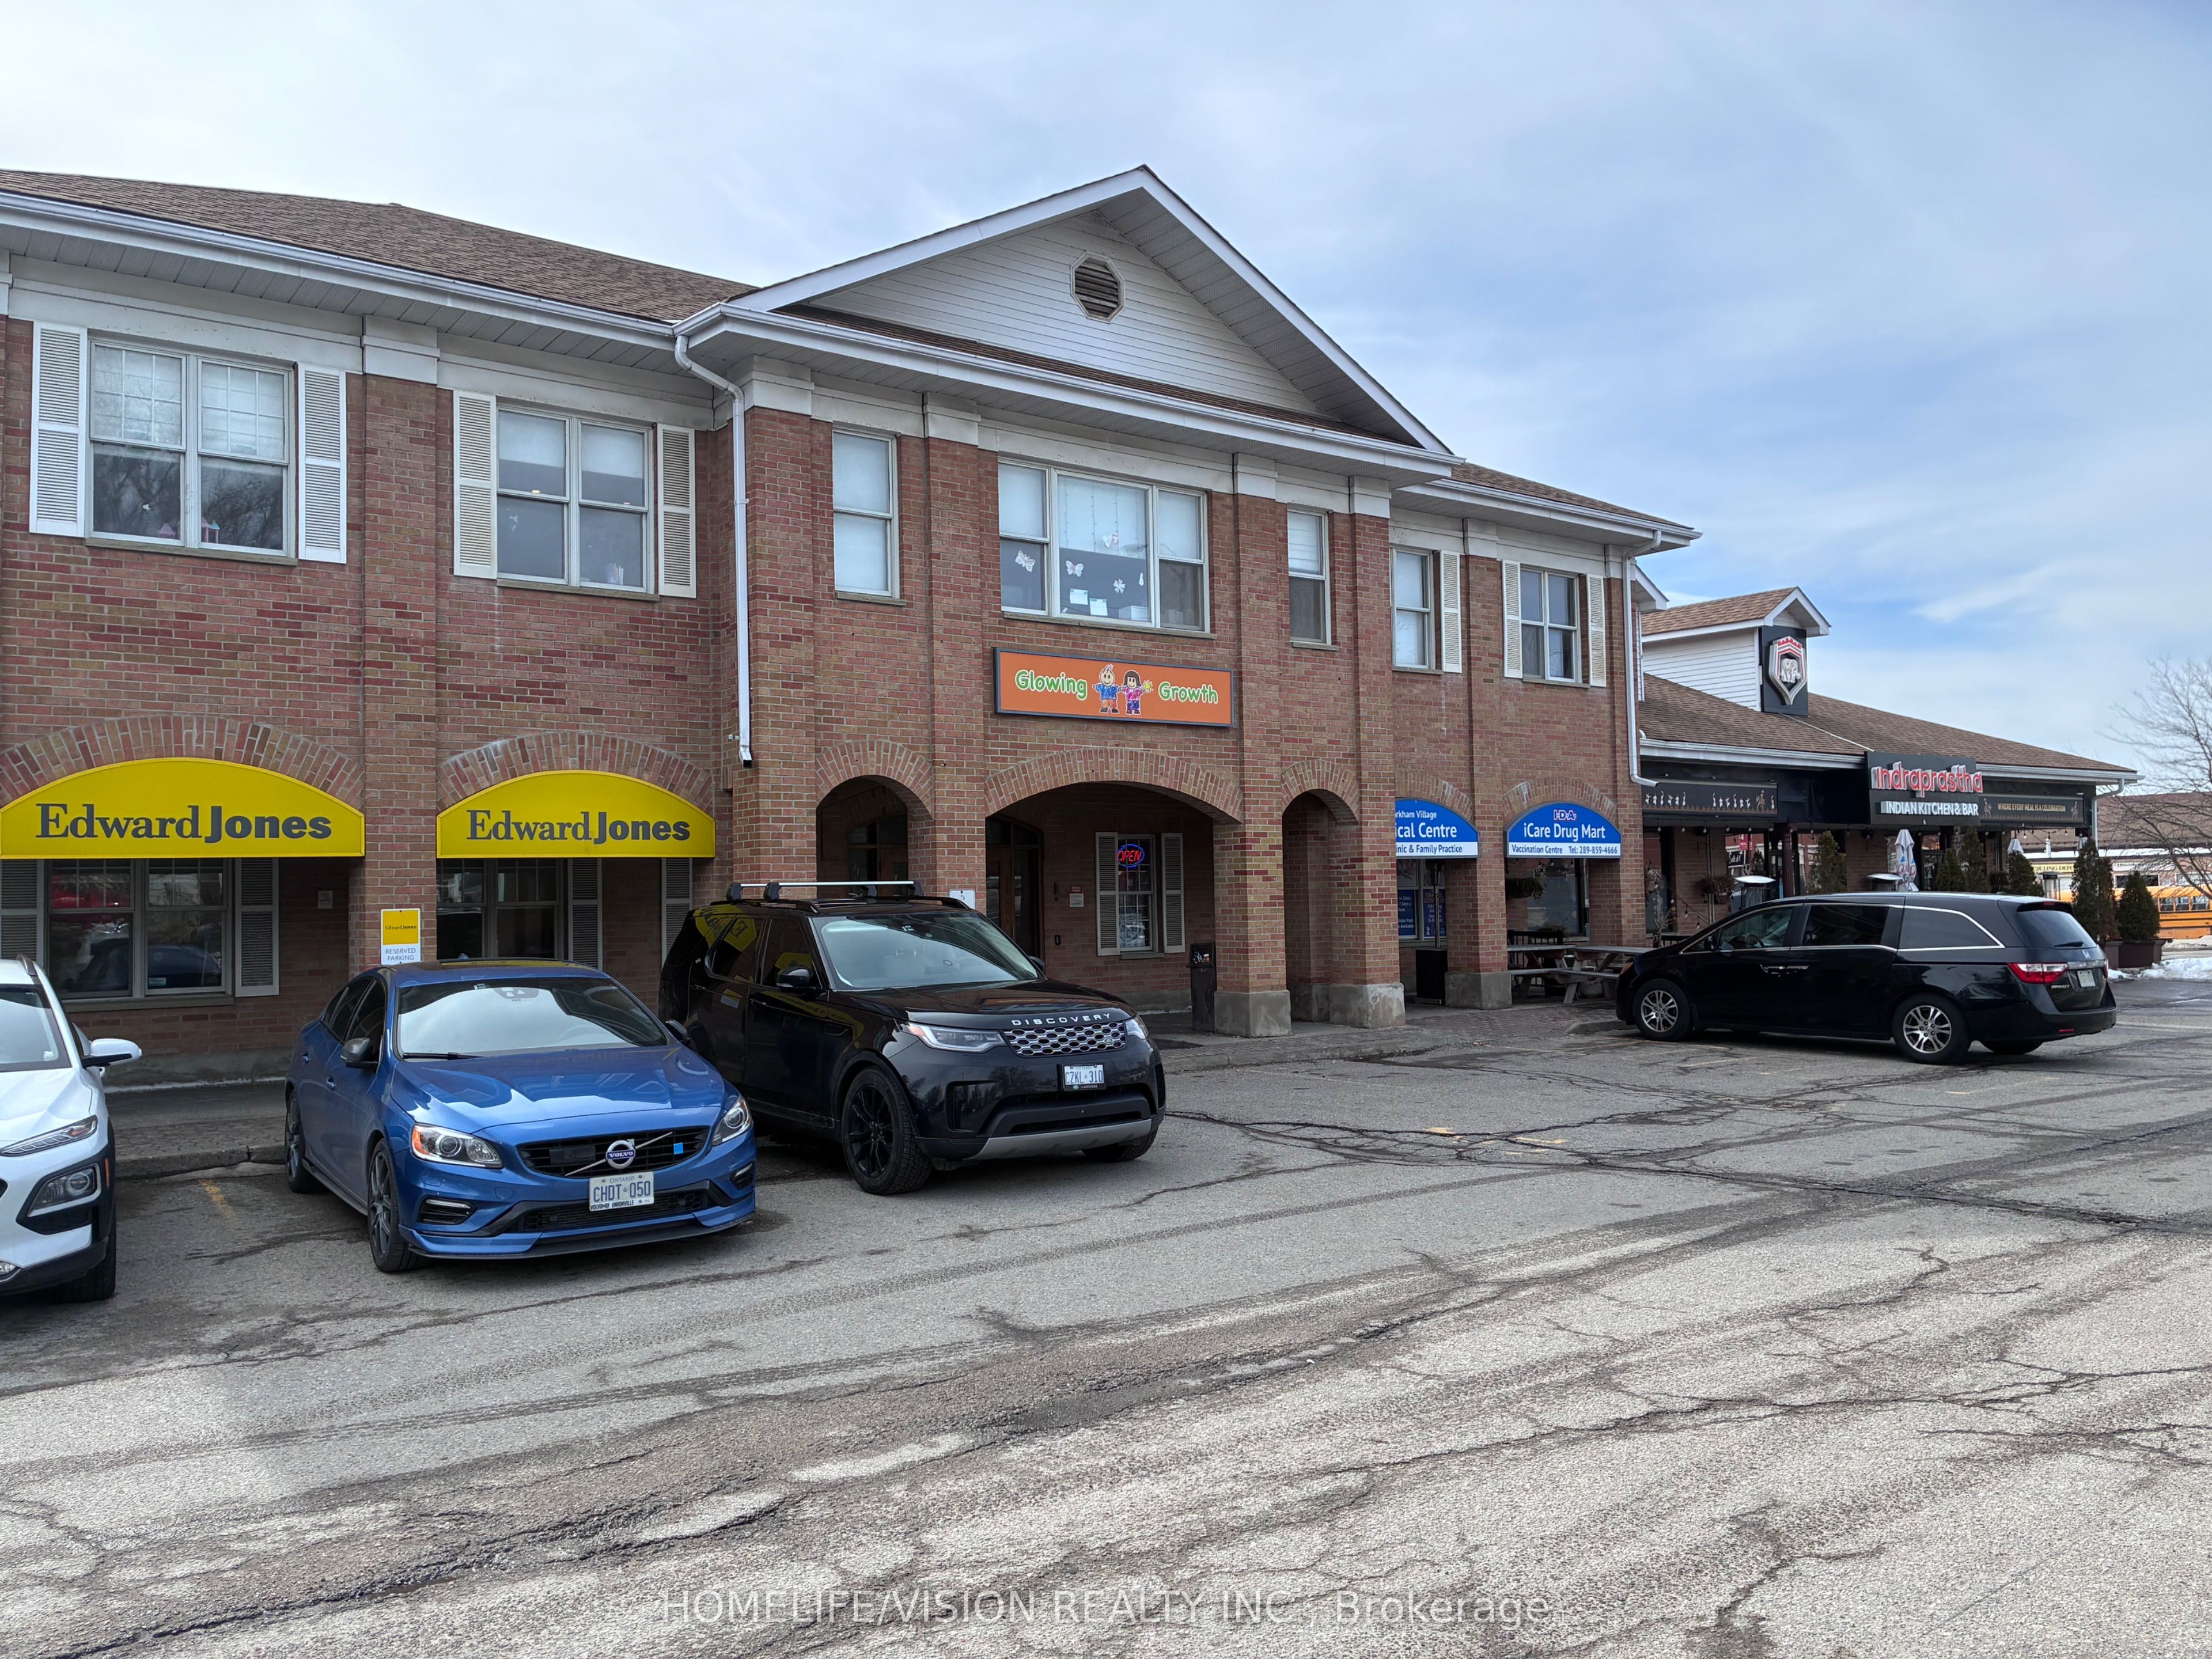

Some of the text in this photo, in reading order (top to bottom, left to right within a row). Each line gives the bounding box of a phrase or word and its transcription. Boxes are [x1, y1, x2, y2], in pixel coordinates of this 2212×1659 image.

[1014, 669, 1219, 704] Glowing Growth
[1395, 810, 1437, 820] rkham Village
[1882, 801, 1979, 816] INDIAN KITCHEN & BAR
[36, 803, 332, 844] Edward Jones
[466, 809, 690, 845] Edward Jones
[1395, 822, 1457, 838] ical Centre
[1524, 823, 1606, 842] iCare Drug Mart
[1408, 844, 1414, 853] &
[1416, 844, 1437, 855] Family
[1438, 844, 1463, 853] Practice
[1512, 844, 1563, 854] Vaccination Centre
[1569, 846, 1618, 855] Tel: 289-859-4666
[1118, 850, 1142, 862] OPEN
[1011, 1013, 1111, 1025] DISCOVERY
[1065, 1070, 1103, 1084] CZKL 310
[609, 1176, 635, 1184] ONTARIO
[630, 1180, 650, 1198] 050
[611, 1200, 634, 1208] UNIONVILLE
